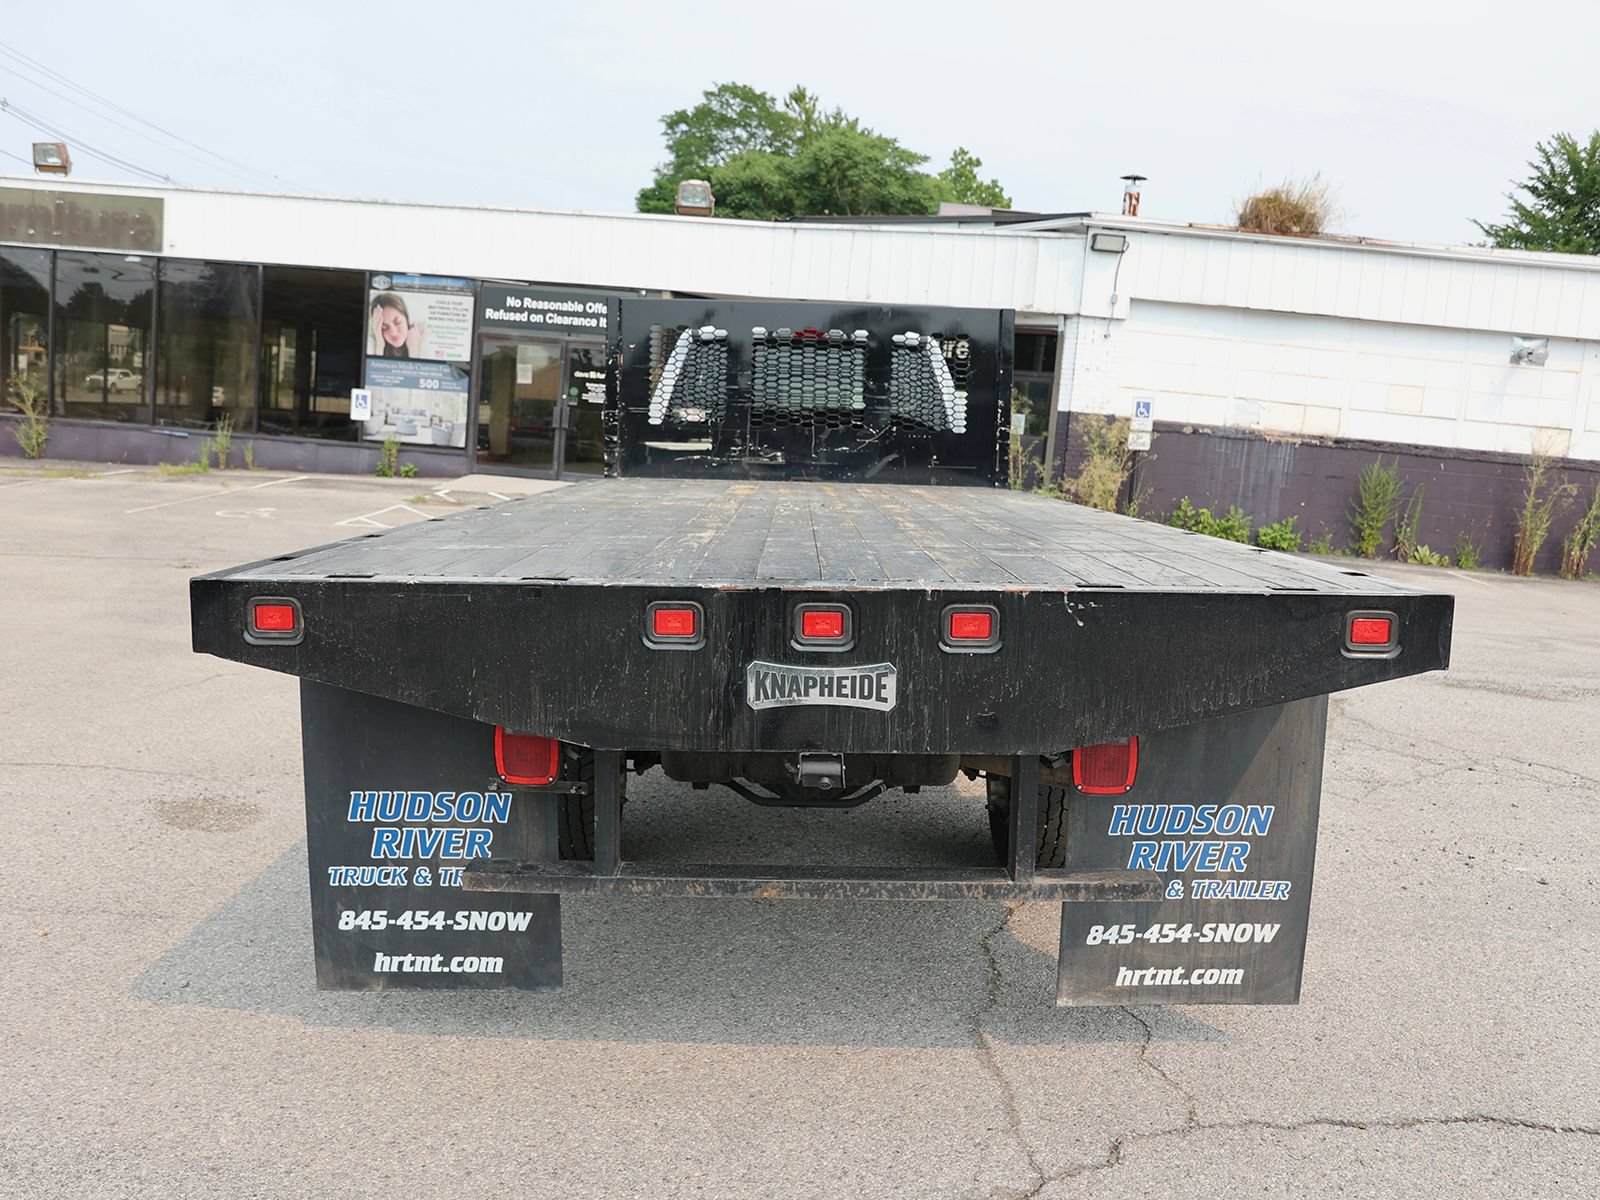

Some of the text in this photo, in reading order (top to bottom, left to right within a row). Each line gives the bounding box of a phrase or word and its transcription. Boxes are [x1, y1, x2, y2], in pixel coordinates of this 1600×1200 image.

[506, 296, 521, 307] No
[523, 297, 584, 312] Reasonable
[485, 308, 528, 322] Refused
[530, 313, 544, 323] on
[545, 312, 597, 327] Clearance
[419, 378, 440, 389] 500
[754, 670, 889, 703] KNAPHEIDE
[347, 791, 512, 823] HUDSON
[1108, 804, 1275, 836] HUDSON
[371, 827, 494, 859] RIVER
[1127, 841, 1251, 872] RIVER
[328, 865, 408, 887] TRUCK
[413, 866, 433, 887] &
[1165, 879, 1291, 901] & TRAILER
[338, 910, 533, 932] 845-454-SNOW
[1085, 923, 1281, 946] 845-454-SNOW
[373, 951, 504, 973] hrtnt.com
[1115, 966, 1245, 987] hrtnt.com
